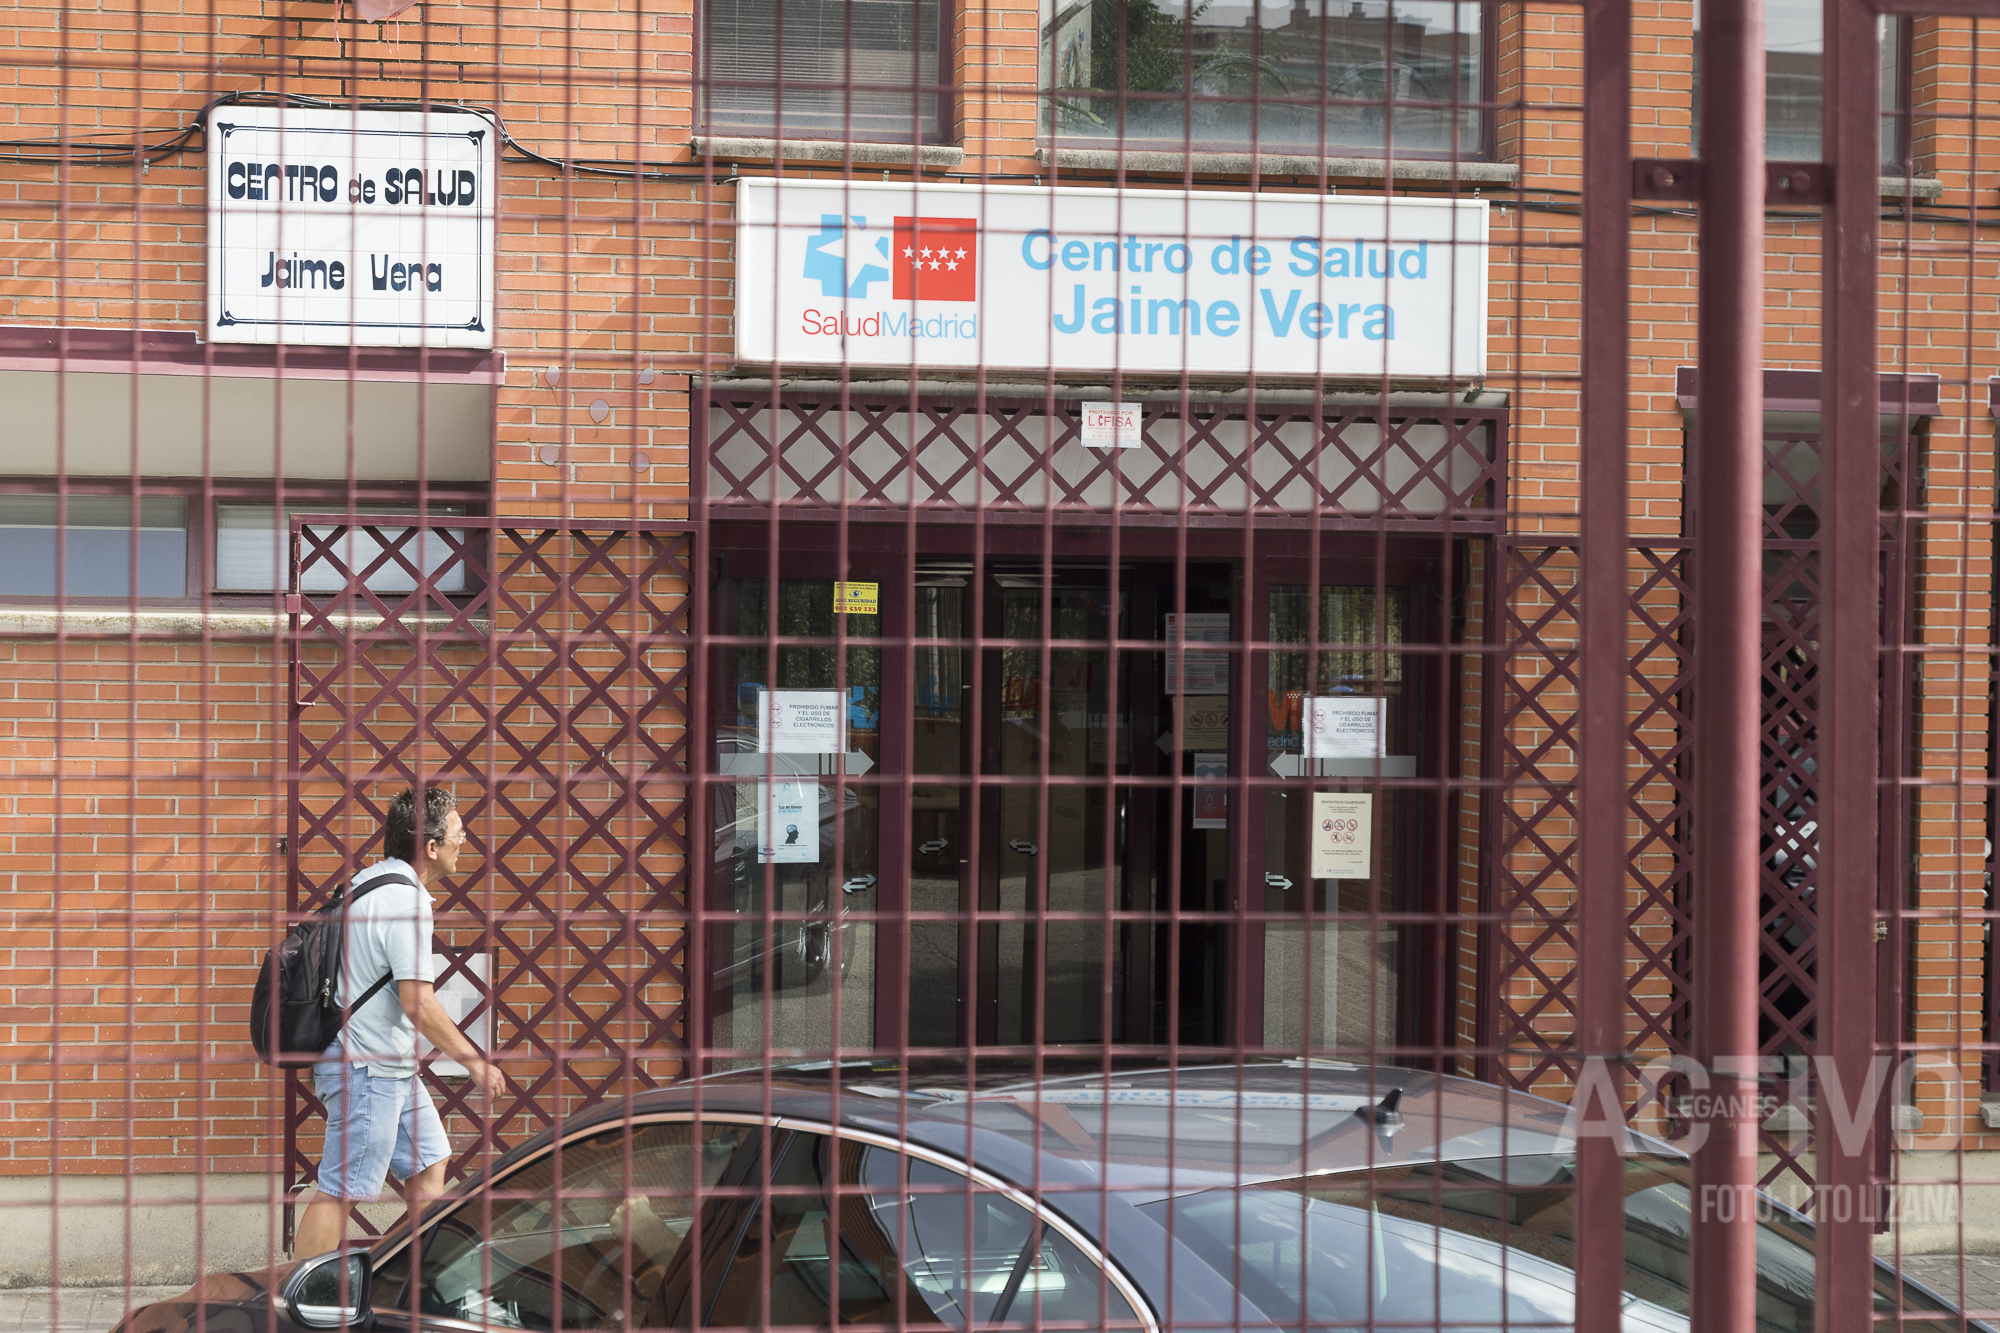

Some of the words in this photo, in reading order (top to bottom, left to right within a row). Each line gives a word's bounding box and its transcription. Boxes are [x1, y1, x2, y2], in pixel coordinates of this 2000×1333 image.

[228, 162, 338, 202] CENTRO
[348, 174, 376, 204] de
[384, 168, 476, 206] SALUD
[262, 252, 345, 290] Jaime
[371, 254, 442, 292] Vera
[1022, 228, 1192, 274] Centro
[1210, 234, 1272, 276] de
[1289, 238, 1428, 280] Salud
[802, 309, 977, 340] SaludMadrid
[1053, 284, 1240, 338] Jaime
[1260, 288, 1395, 340] Vera
[1268, 735, 1299, 747] adrid
